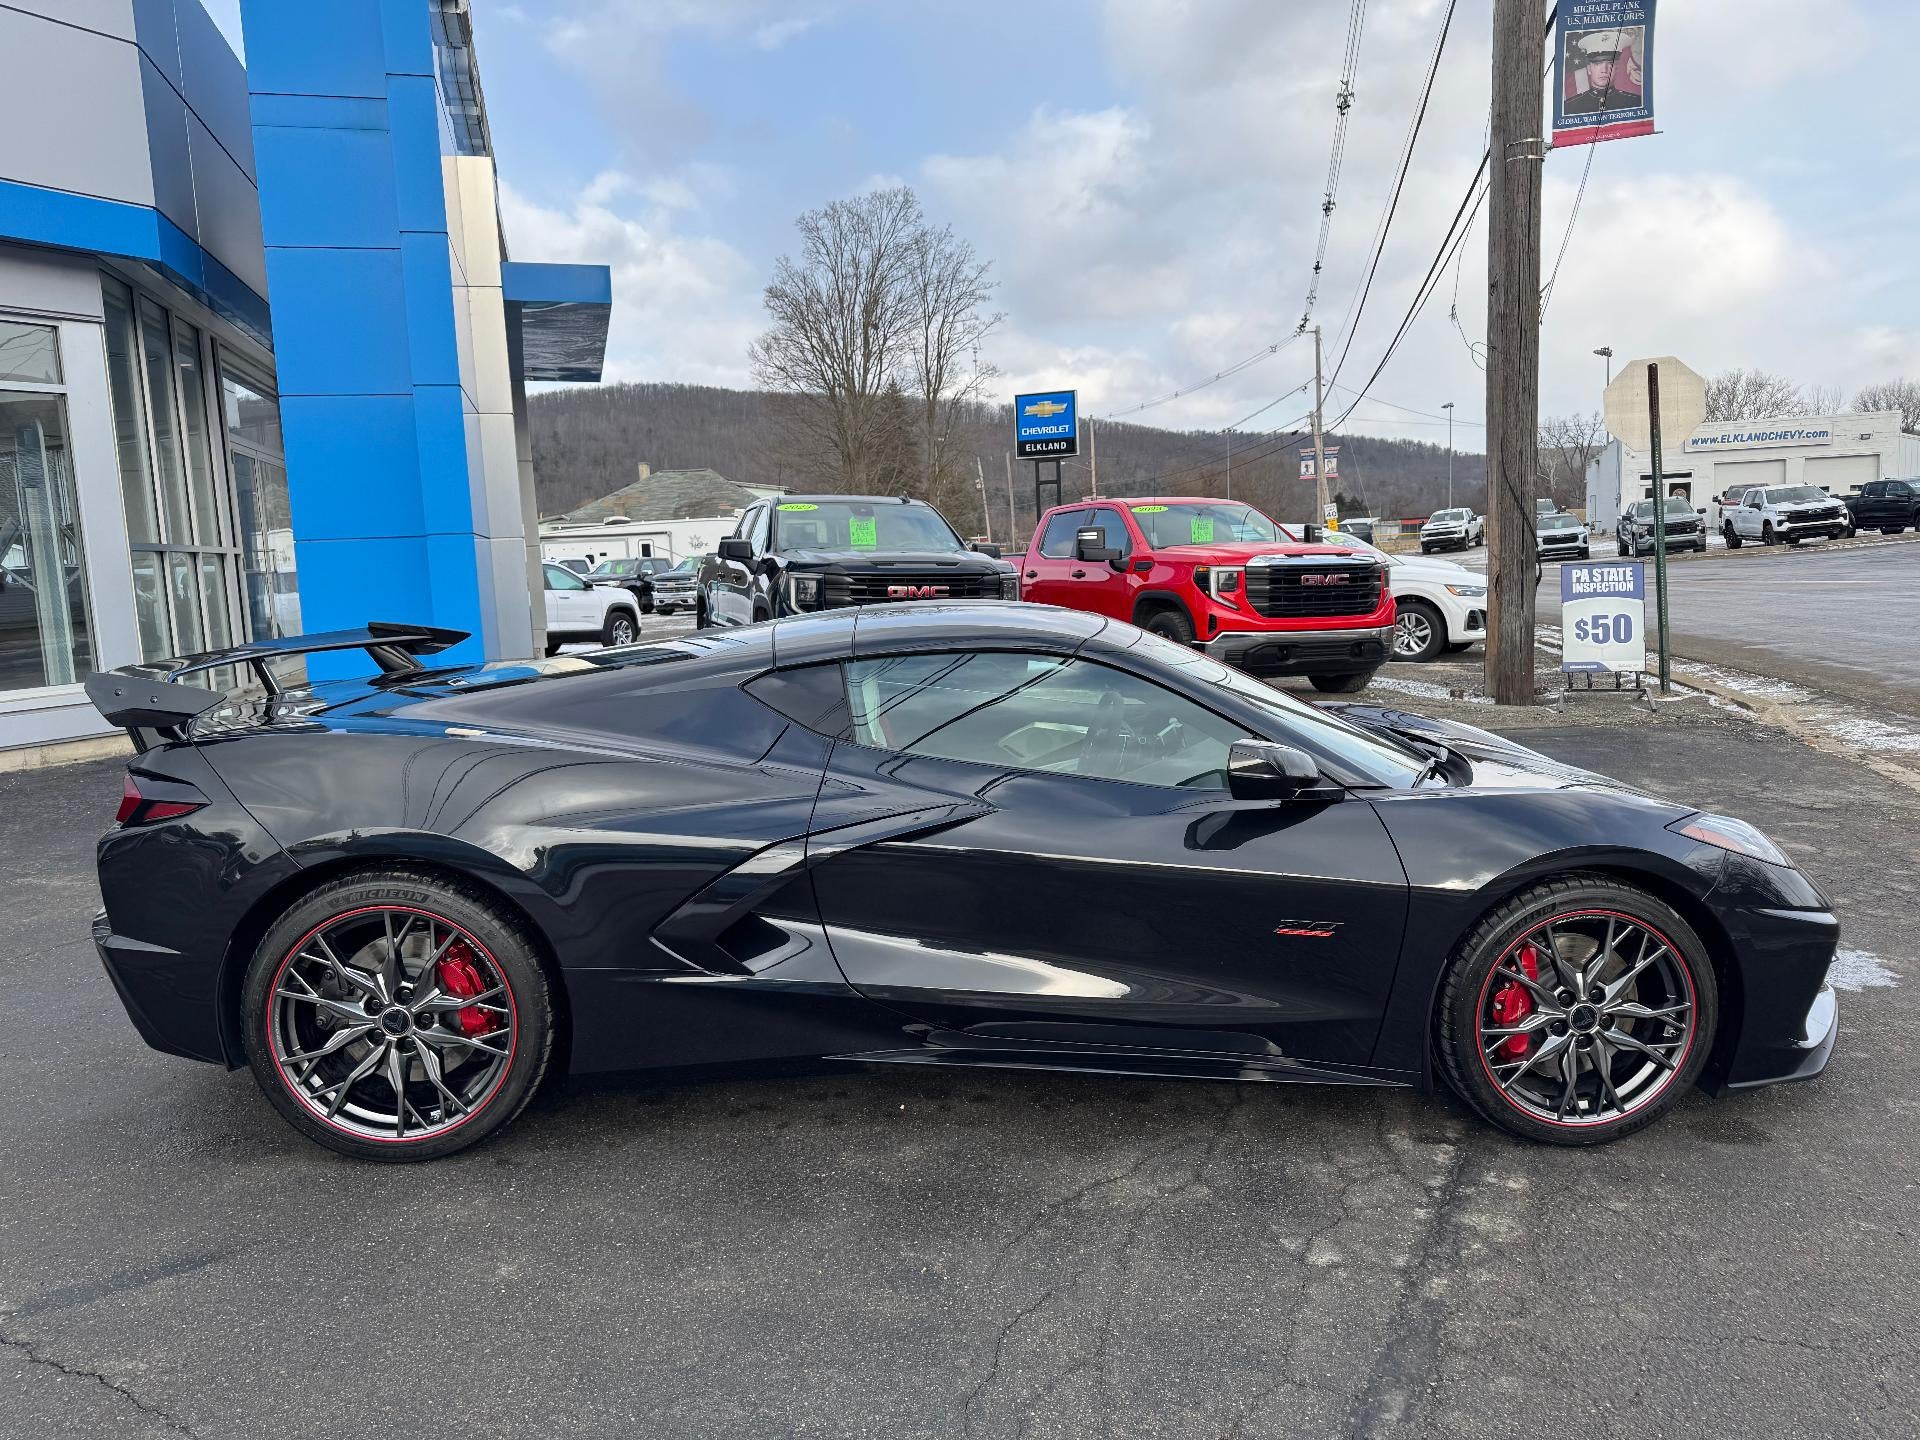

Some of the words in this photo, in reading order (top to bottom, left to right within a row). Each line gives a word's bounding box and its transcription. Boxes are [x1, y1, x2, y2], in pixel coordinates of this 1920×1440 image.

[1573, 4, 1610, 13] MICHAEL
[1567, 17, 1582, 25] U.S.
[1583, 14, 1616, 24] MARINE
[1617, 11, 1645, 22] CORPS
[1022, 424, 1070, 435] CHEVROLET
[1691, 429, 1829, 446] www.ELKLANDCHEVY.com
[1026, 441, 1067, 451] ELKLAND
[1301, 574, 1349, 585] GMC
[1572, 568, 1590, 582] PA
[1593, 567, 1633, 582] STATE
[888, 586, 949, 597] GMC
[1572, 581, 1634, 593] INSPECTION
[1574, 613, 1633, 644] $50
[349, 888, 424, 902] MICHELIN
